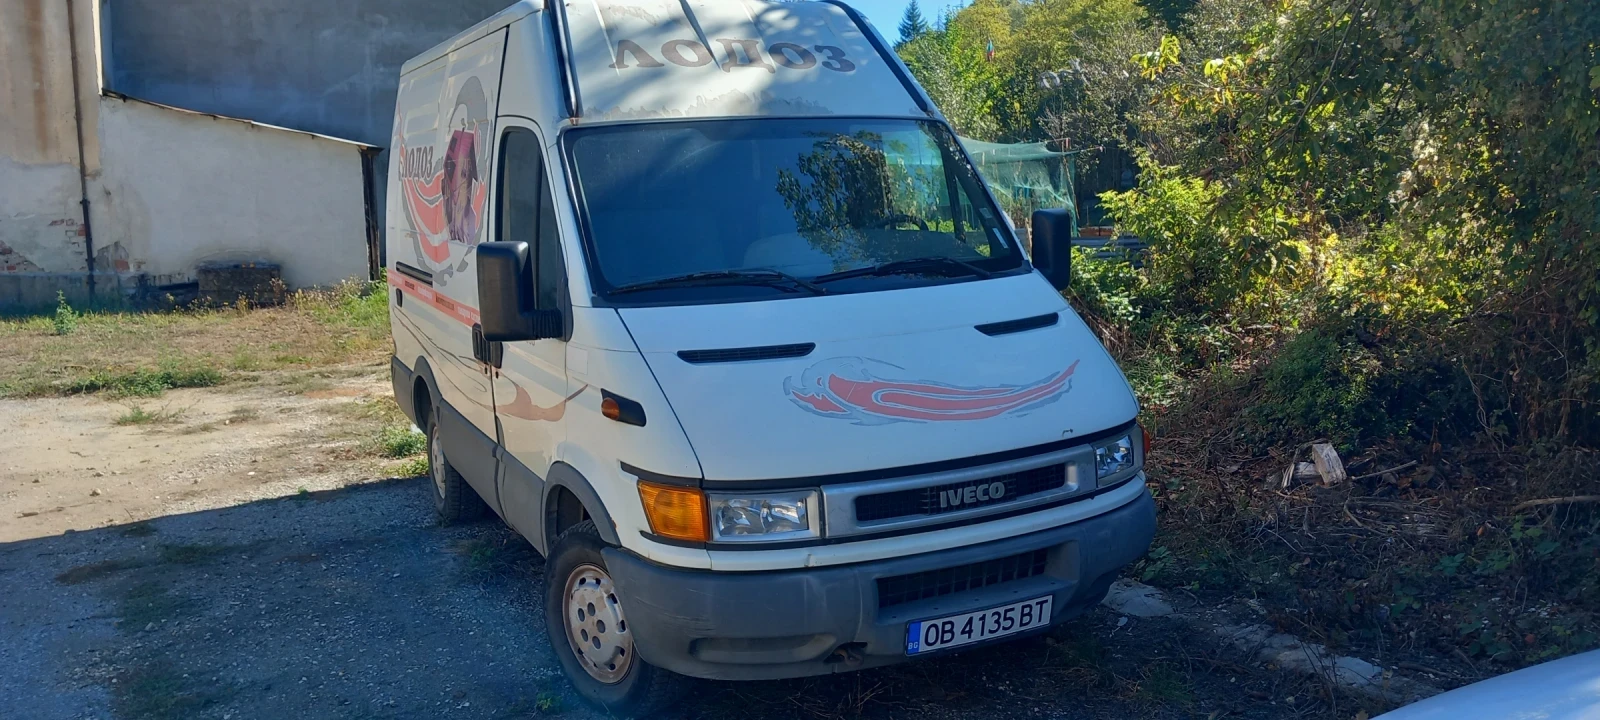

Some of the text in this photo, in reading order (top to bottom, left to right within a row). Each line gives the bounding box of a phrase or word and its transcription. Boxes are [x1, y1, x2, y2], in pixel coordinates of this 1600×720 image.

[608, 38, 856, 74] ЛОДОЗ
[940, 481, 1005, 508] IVECO
[924, 599, 1049, 647] OB 4135 BT
